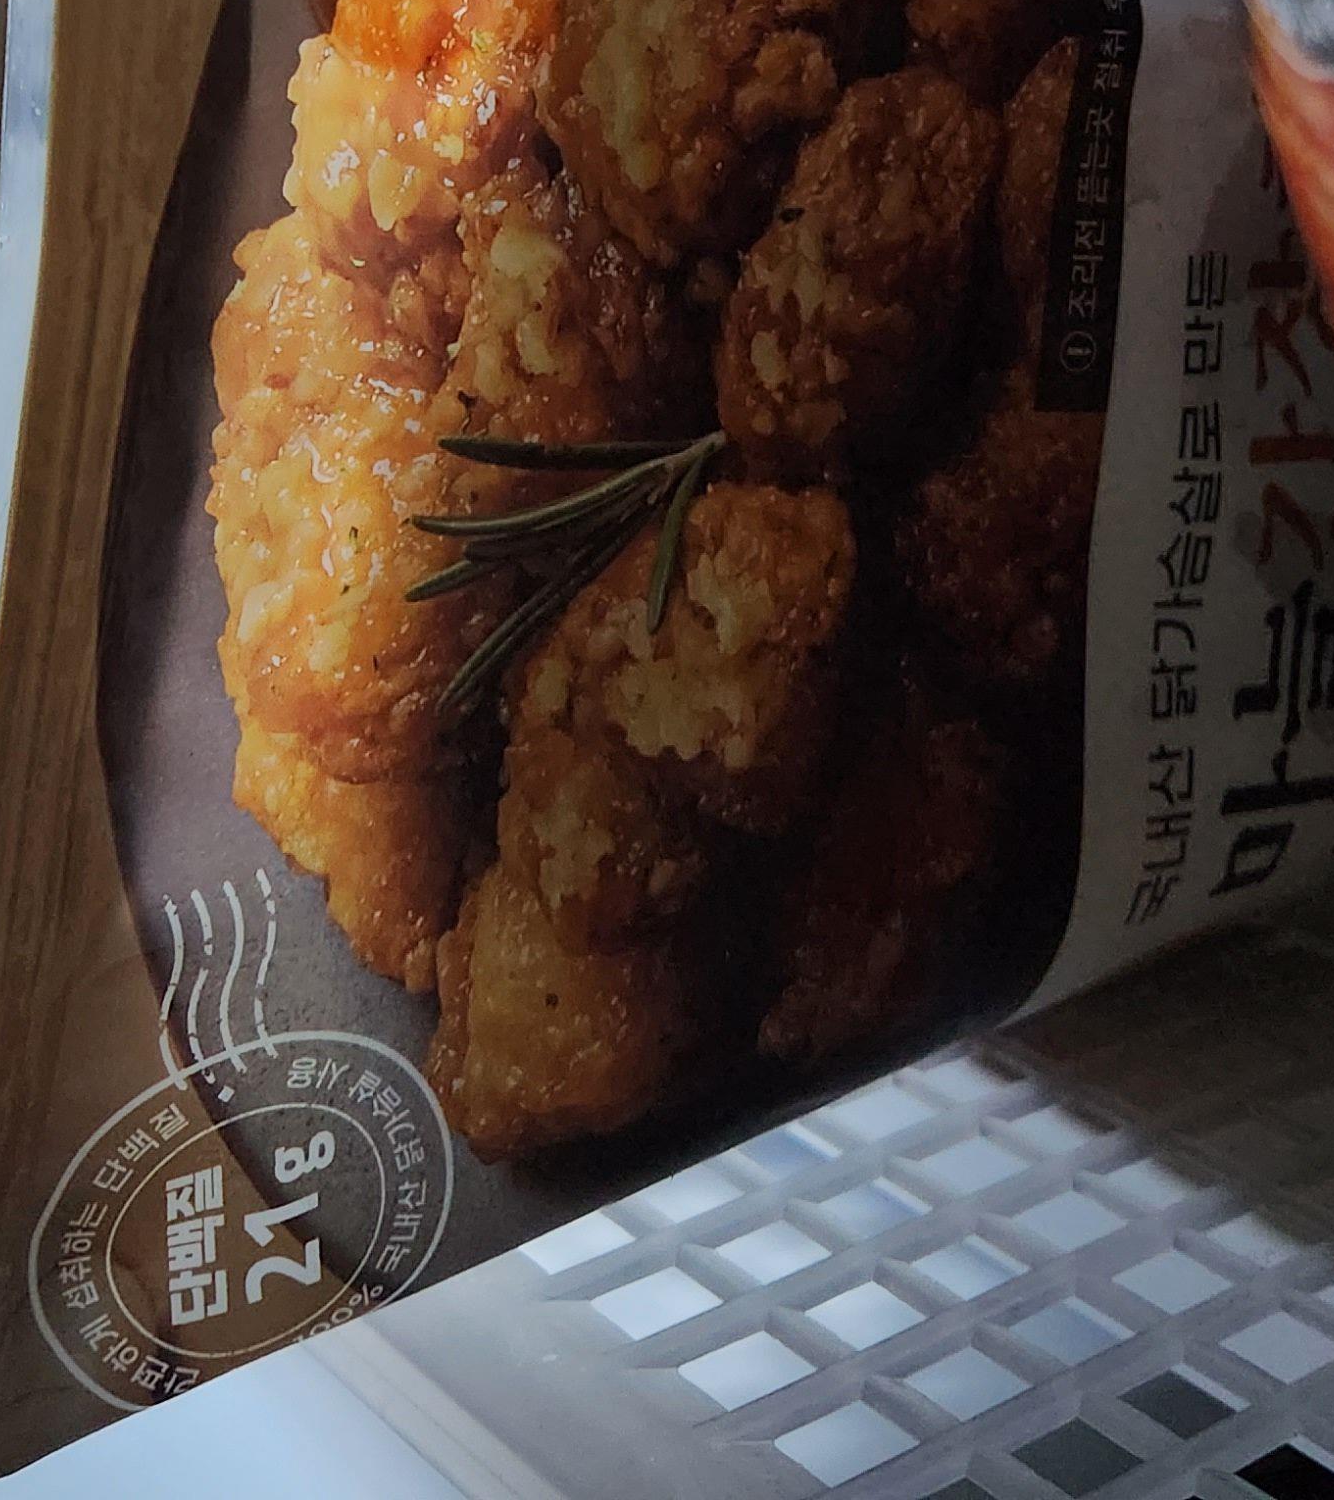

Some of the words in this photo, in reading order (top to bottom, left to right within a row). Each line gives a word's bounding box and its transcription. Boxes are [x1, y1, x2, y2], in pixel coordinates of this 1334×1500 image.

[1069, 222, 1104, 323] 조리전
[1183, 250, 1228, 377] 만든
[1150, 400, 1223, 718] 닭가슴살로
[1125, 744, 1195, 926] 국내산
[287, 1055, 347, 1091] 사용
[348, 1066, 425, 1174] 닭가슴살
[58, 1203, 108, 1309] 섭취하는
[93, 1103, 191, 1193] 단백질
[166, 1164, 229, 1327] 단백질
[375, 1177, 428, 1273] 국내산
